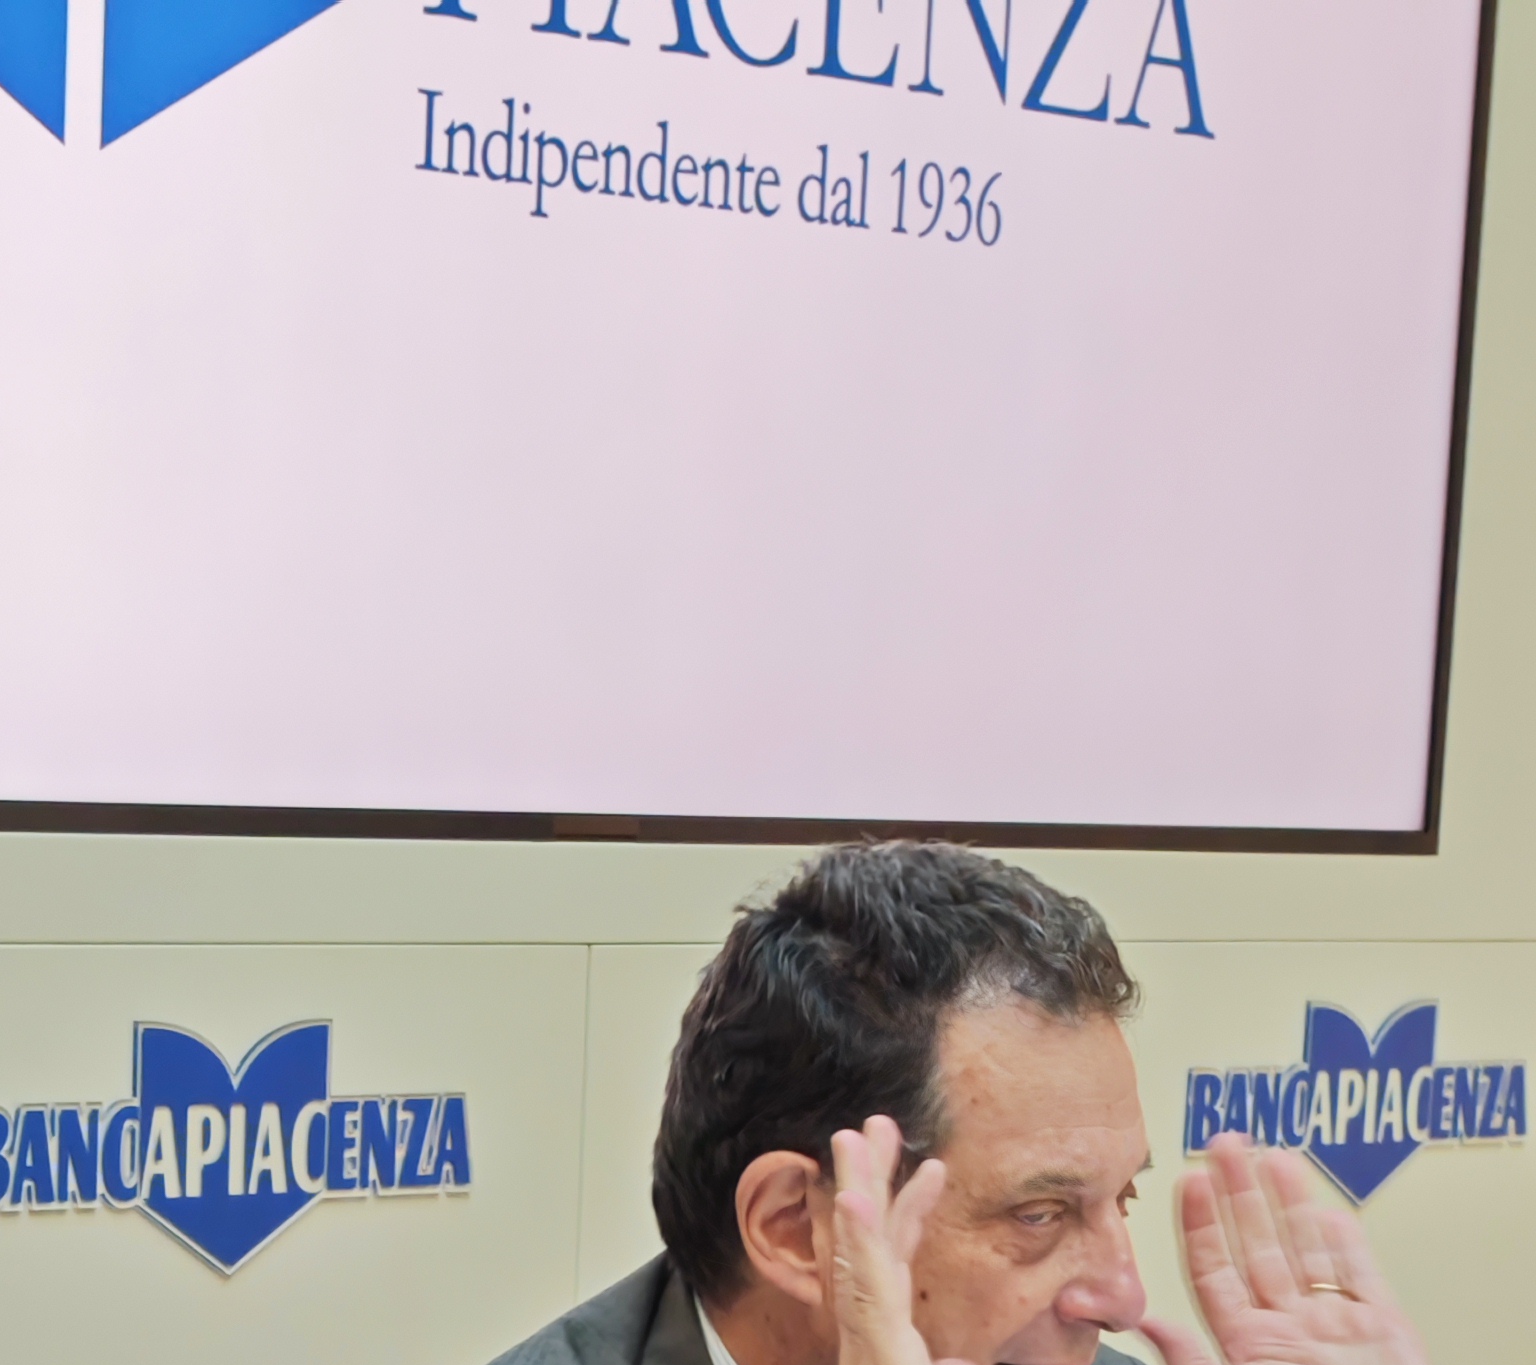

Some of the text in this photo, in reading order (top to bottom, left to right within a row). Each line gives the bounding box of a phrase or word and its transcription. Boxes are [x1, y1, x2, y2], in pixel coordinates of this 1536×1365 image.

[415, 87, 1004, 247] Indipendente dal 1936
[1190, 1064, 1527, 1151] BANCAPIACENZA
